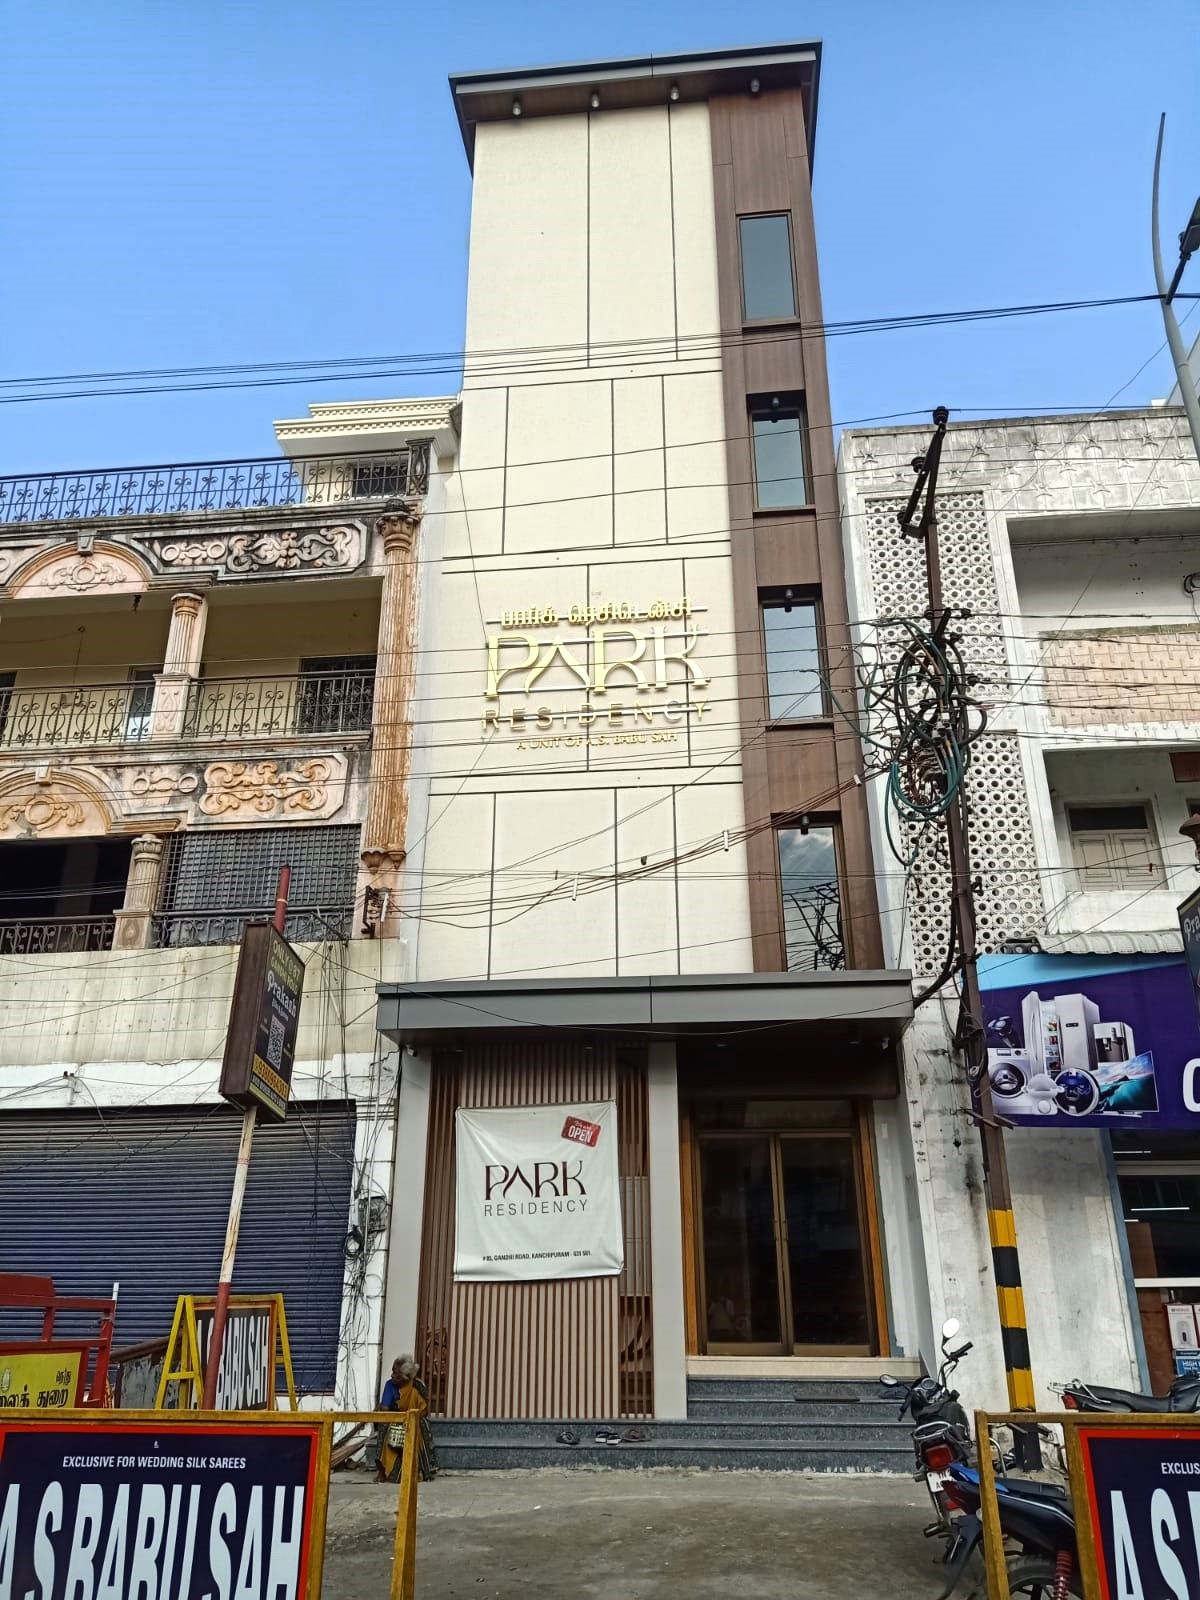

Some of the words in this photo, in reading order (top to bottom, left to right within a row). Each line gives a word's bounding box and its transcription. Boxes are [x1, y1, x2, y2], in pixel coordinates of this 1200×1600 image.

[485, 624, 709, 698] PARK
[481, 696, 709, 731] RESIDENCY
[613, 732, 648, 744] BABU
[267, 970, 297, 1019] Prakash
[568, 1125, 593, 1143] OPEN
[485, 1160, 587, 1200] PARK
[484, 1199, 588, 1217] RESIDENCY
[246, 1315, 270, 1407] SAH
[62, 1455, 115, 1468] EXCLUSIVE
[117, 1456, 135, 1468] FOR
[138, 1456, 184, 1469] WEDDING
[186, 1457, 207, 1469] SILK
[209, 1457, 247, 1469] SAREES
